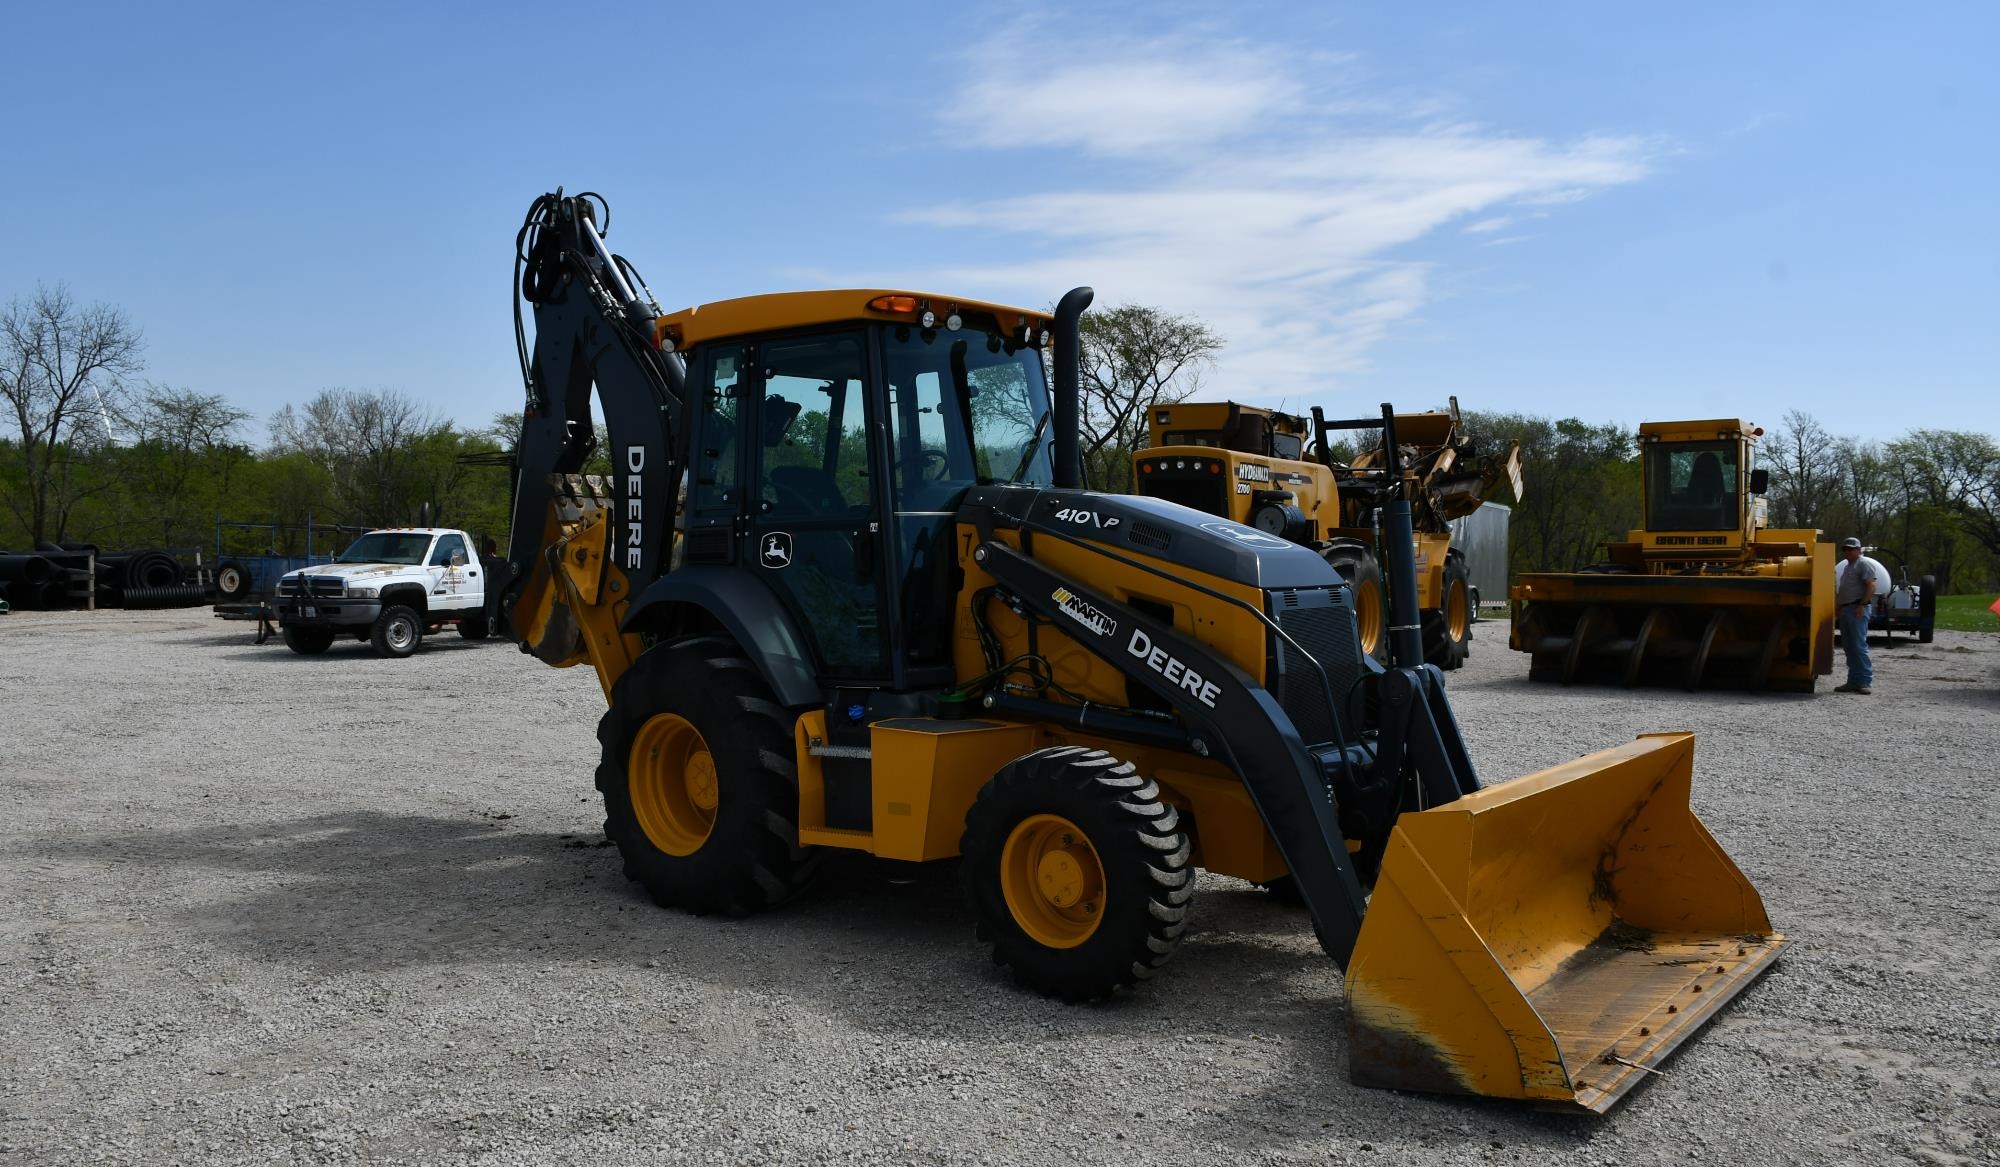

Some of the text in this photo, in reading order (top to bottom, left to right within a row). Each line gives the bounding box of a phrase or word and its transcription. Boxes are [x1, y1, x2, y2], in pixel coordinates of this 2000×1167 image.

[628, 446, 645, 569] DEERE
[1064, 594, 1117, 636] MARTIN
[1127, 628, 1222, 709] DEERE
